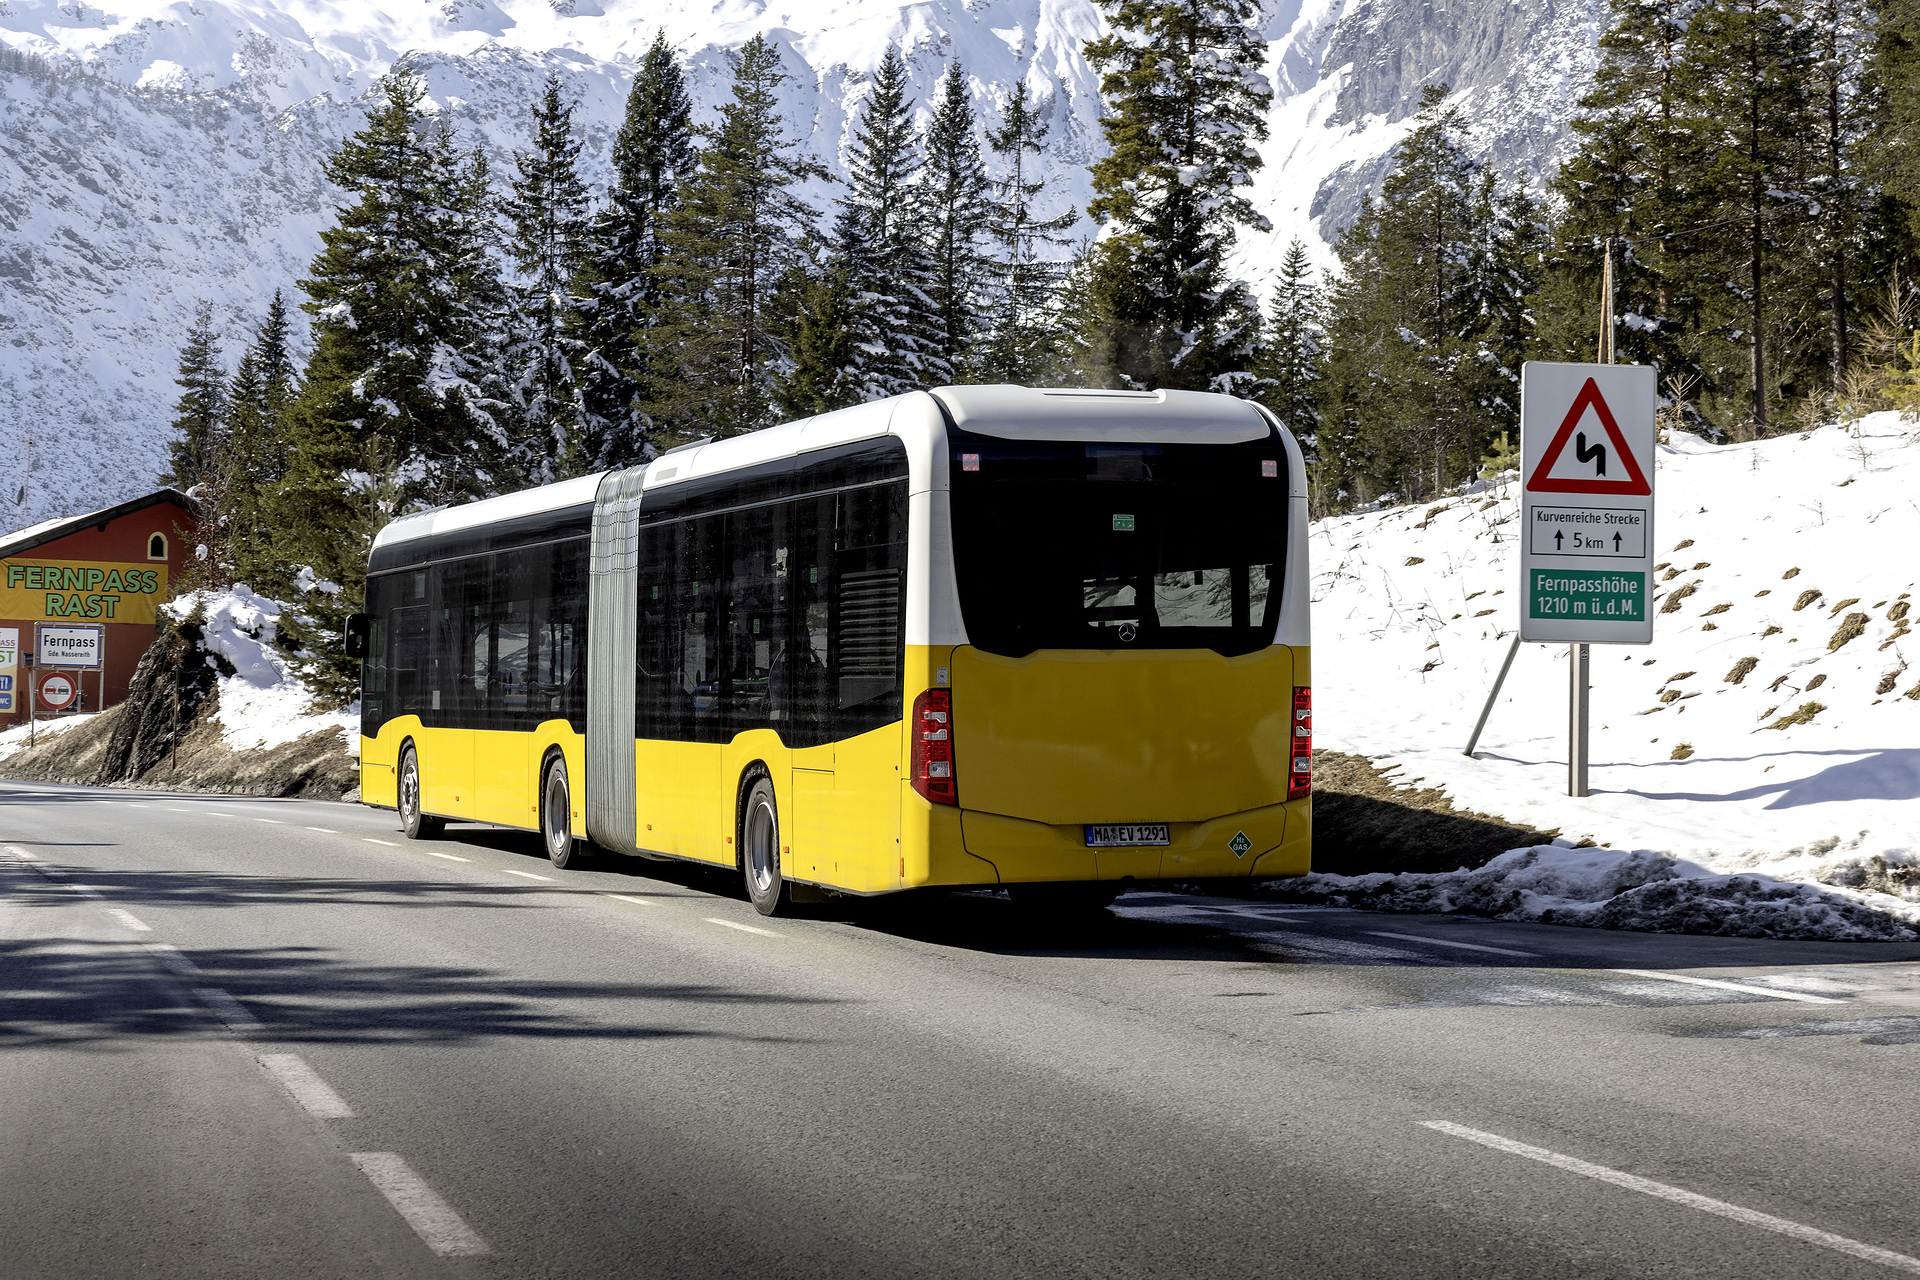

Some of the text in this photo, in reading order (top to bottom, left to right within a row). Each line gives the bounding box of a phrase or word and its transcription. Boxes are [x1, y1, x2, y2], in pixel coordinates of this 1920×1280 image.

[1537, 511, 1640, 525] Kurvenreiche Strecke
[1573, 532, 1604, 549] 5 km
[7, 565, 158, 594] FERNPASS
[1537, 574, 1638, 595] Fernpasshöhe
[46, 593, 120, 618] RAST
[1538, 597, 1637, 616] 1210 m ü.d.M.
[0, 639, 16, 647] ASS
[43, 634, 95, 649] Fernpass
[0, 649, 15, 663] ST
[1137, 827, 1167, 841] 1291
[1232, 843, 1248, 851] GAS
